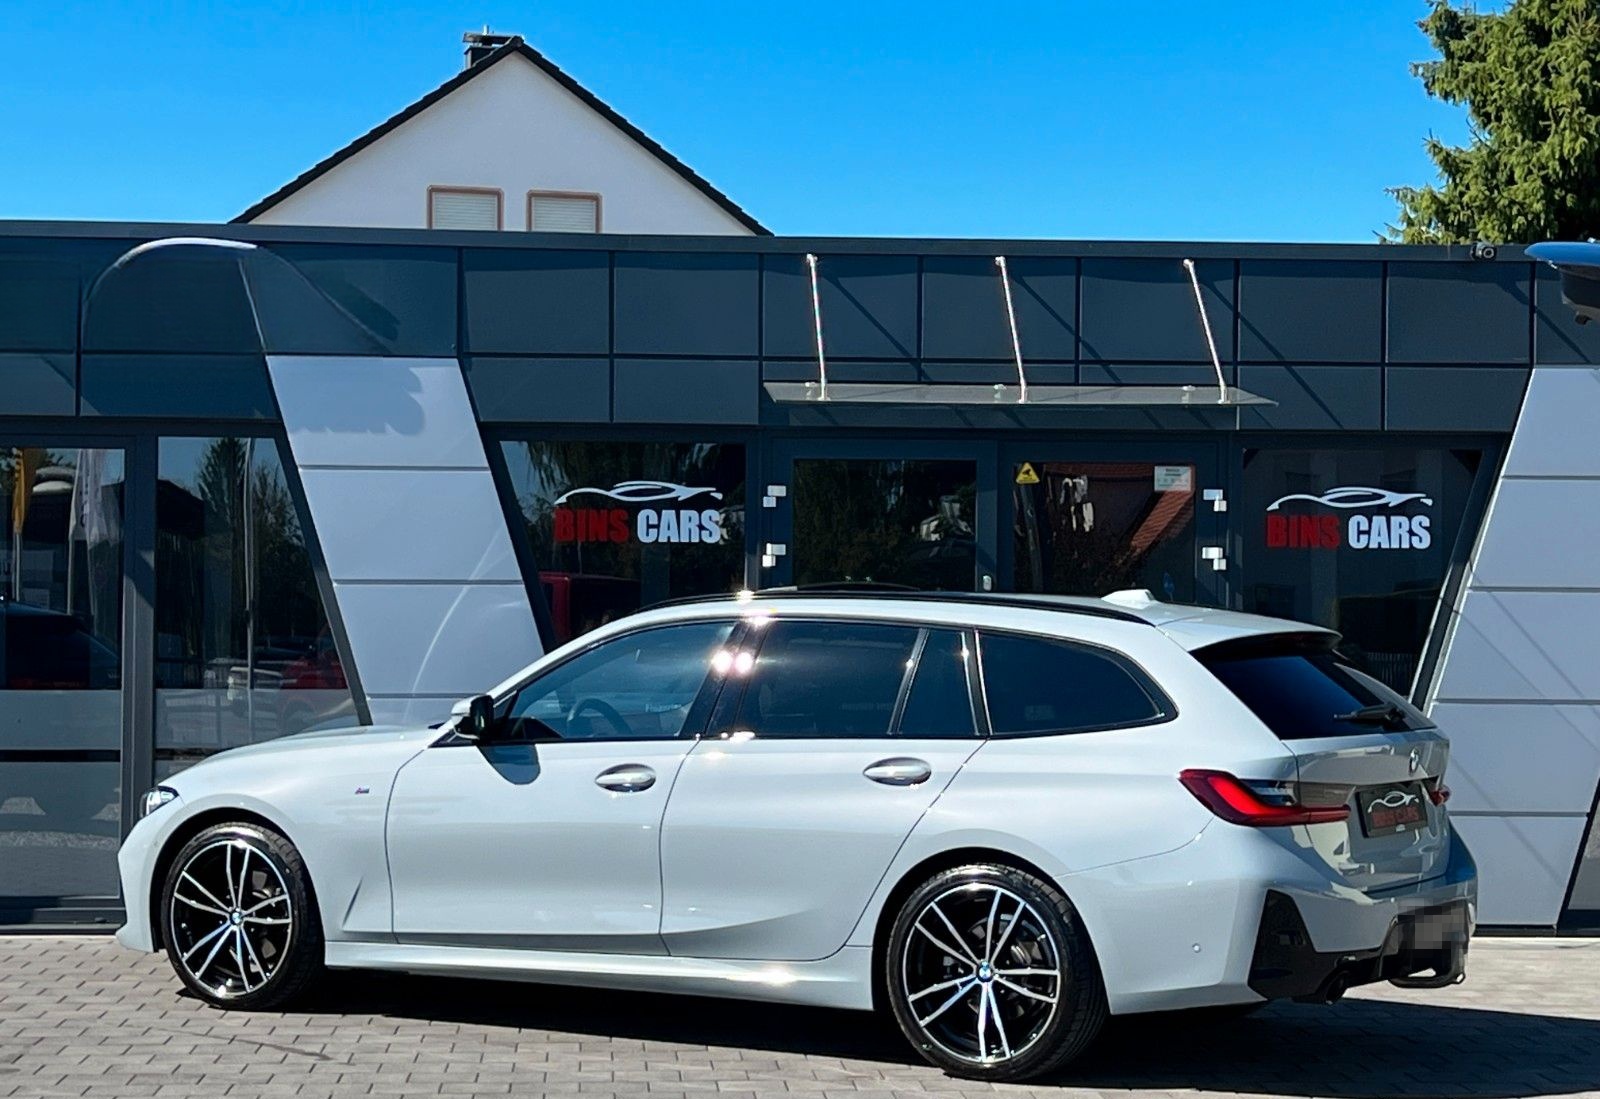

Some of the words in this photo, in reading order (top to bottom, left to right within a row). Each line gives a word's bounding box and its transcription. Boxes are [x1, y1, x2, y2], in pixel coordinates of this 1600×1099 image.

[554, 508, 629, 543] BINS
[637, 508, 721, 543] CARS
[1266, 514, 1340, 548] BINS
[1348, 514, 1431, 549] CARS
